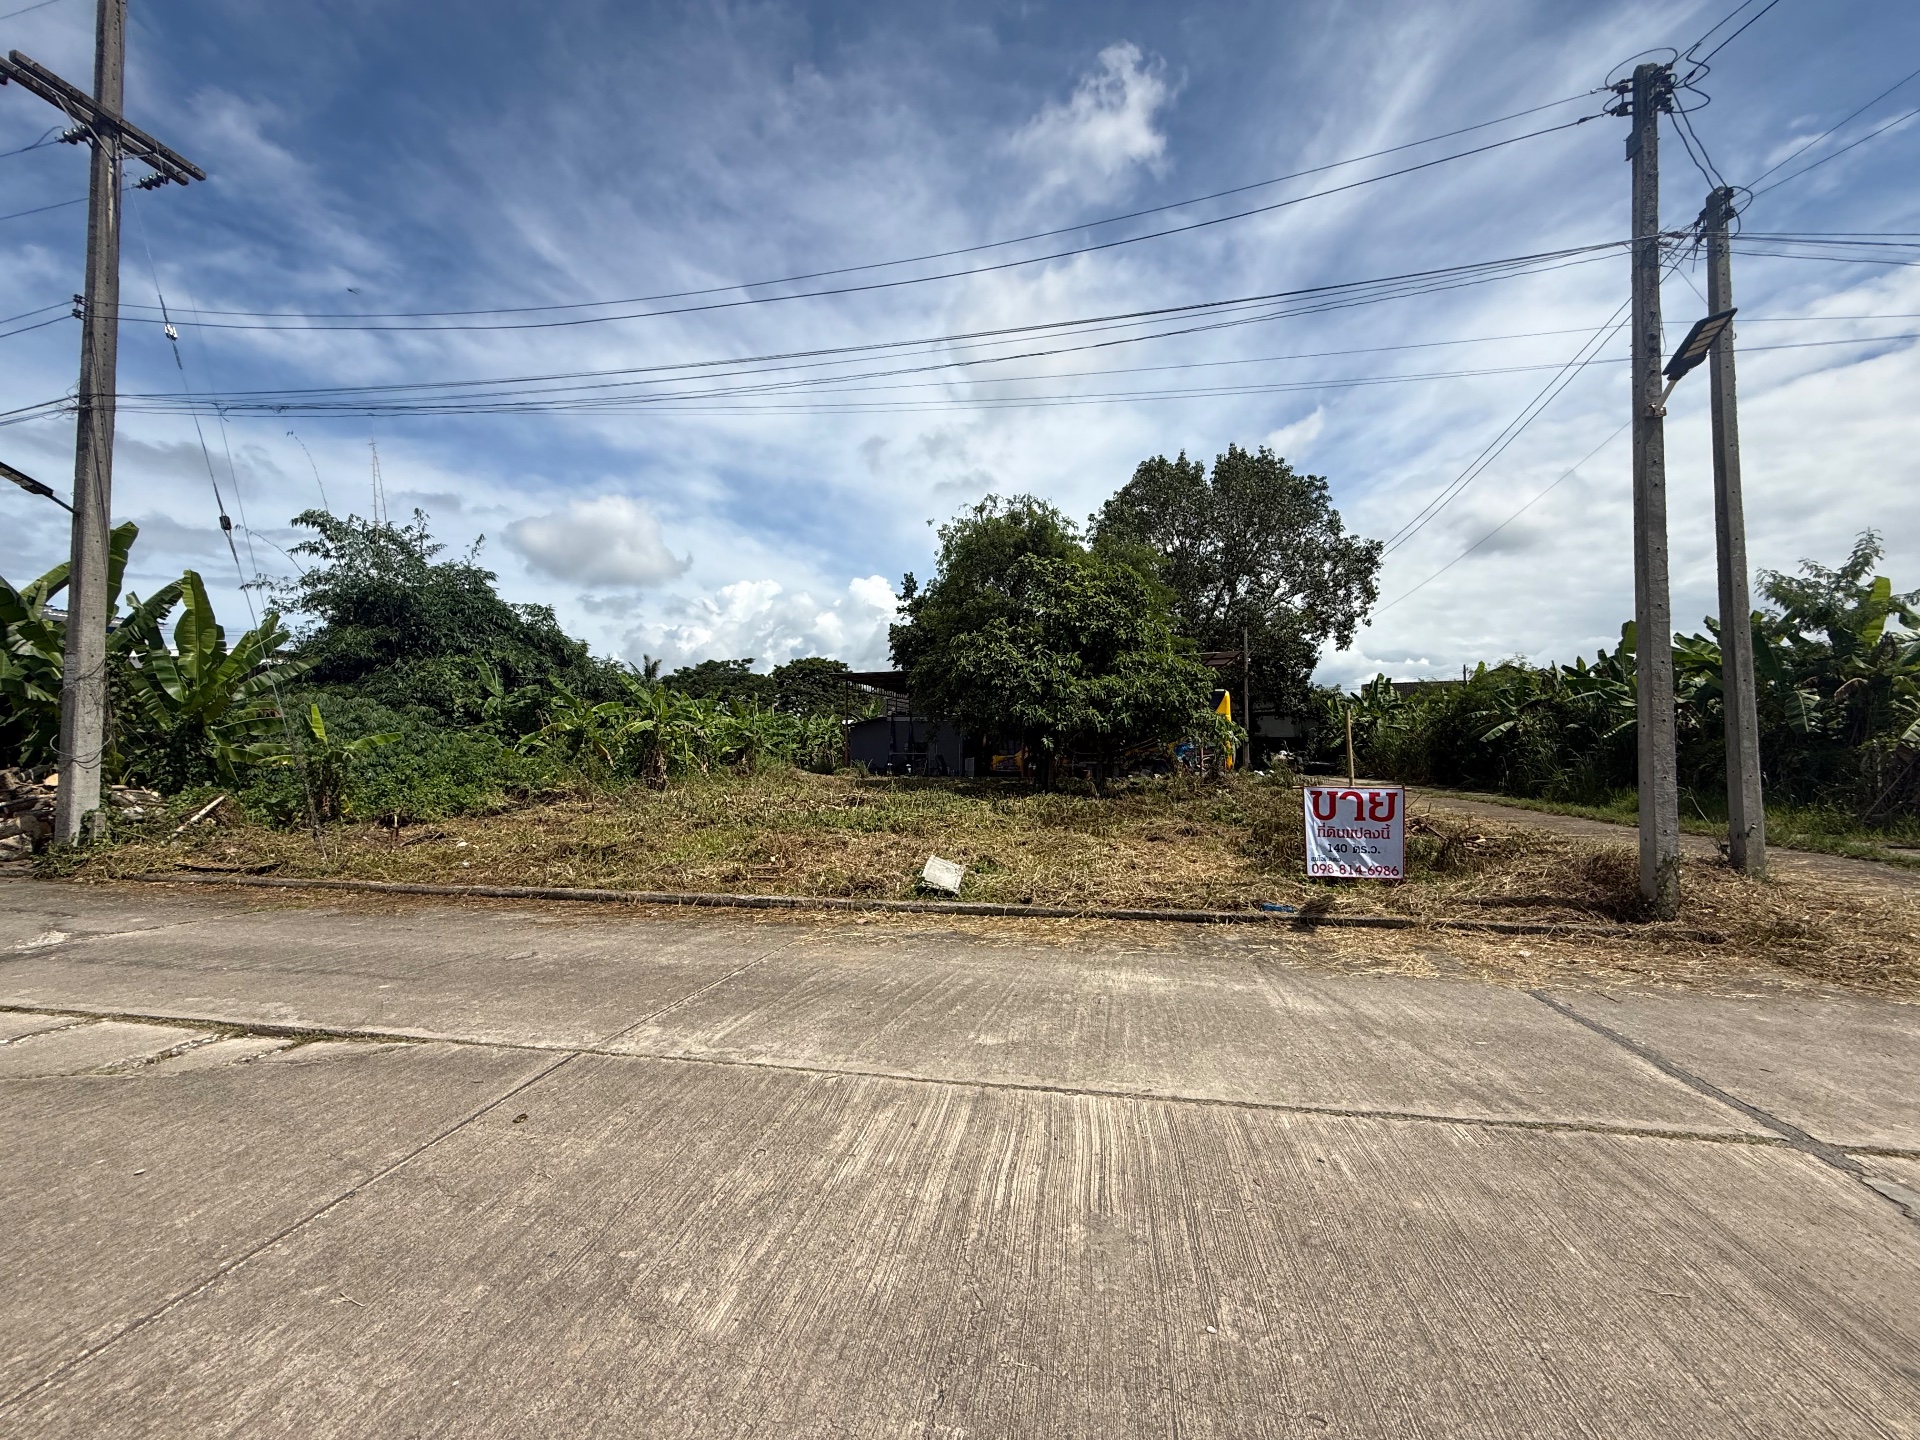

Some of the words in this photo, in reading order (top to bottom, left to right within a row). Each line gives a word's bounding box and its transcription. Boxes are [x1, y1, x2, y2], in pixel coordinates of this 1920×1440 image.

[1310, 791, 1398, 822] ขาย
[1317, 823, 1391, 839] ที่ดินแปลงนี้
[1328, 843, 1347, 853] 140
[1352, 845, 1381, 854] ตร.ว.
[1311, 864, 1399, 876] 098-814-6986
